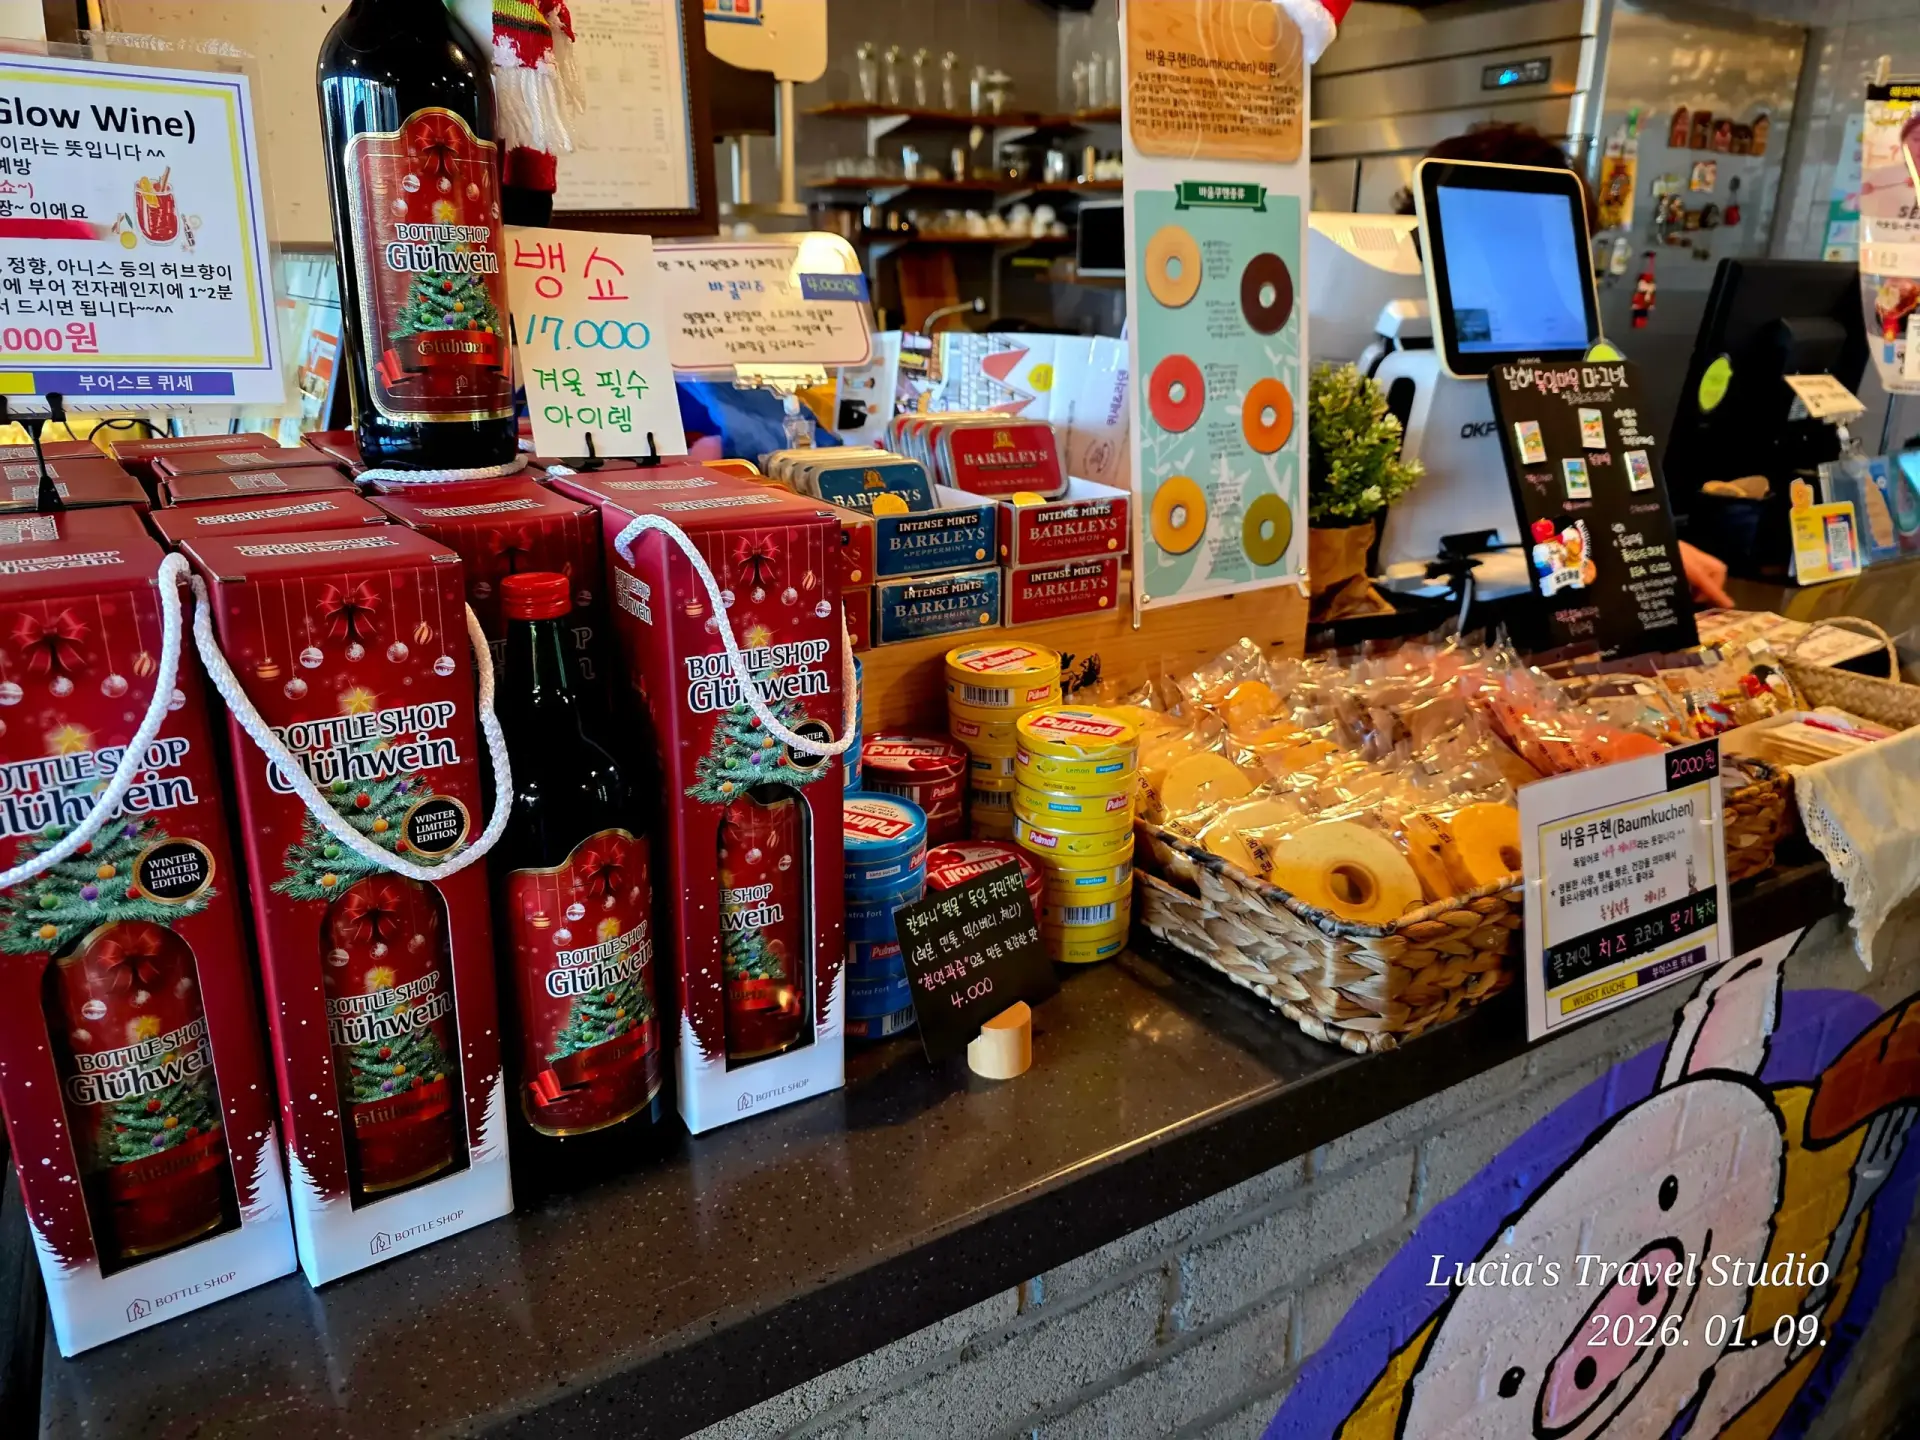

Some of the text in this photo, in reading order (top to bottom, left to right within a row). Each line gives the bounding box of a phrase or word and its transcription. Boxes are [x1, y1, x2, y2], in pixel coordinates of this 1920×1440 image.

[90, 105, 195, 144] Wine)
[65, 140, 141, 161] 뜻입니다
[30, 202, 88, 219] 이에요
[386, 242, 499, 273] Glühwein
[7, 257, 233, 281] 정향, 아니스 등의 허브향이
[0, 278, 233, 301] 에 부어 전자레인지에 1~2분
[17, 299, 74, 317] 드시면
[526, 314, 650, 351] 17.000
[78, 374, 194, 392] 부어스트 퀴세
[532, 368, 650, 400] 겨울 필수
[899, 515, 977, 532] INTENSE MINTS
[1038, 506, 1110, 522] INTENSE MINTS
[890, 527, 985, 550] BARKLEYS
[1029, 518, 1117, 540] BARKLEYS
[1031, 565, 1101, 582] INTENSE MINTS
[904, 581, 981, 599] INTENSE MINTS
[1023, 577, 1108, 599] BARKLEYS
[894, 592, 989, 617] BARKLEYS
[1036, 716, 1118, 736] Pulmoll
[867, 745, 944, 756] Pulmoll
[1671, 750, 1716, 779] 2000원
[415, 808, 456, 825] WINTER
[416, 819, 457, 834] LIMITED
[1560, 799, 1694, 850] 바움쿠헨(Baumkuchen)
[416, 828, 458, 844] EDITION
[1030, 833, 1056, 847] Pulmoll
[148, 852, 198, 870] WINTER
[150, 862, 199, 880] LIMITED
[152, 872, 201, 890] EDITION
[968, 887, 988, 908] 독일
[867, 910, 882, 918] Fort
[950, 977, 993, 1008] 4.000
[1573, 989, 1599, 1007] WURST
[756, 1078, 810, 1103] BOTTLE SHOP
[394, 1209, 464, 1243] BOTTLE SHOP
[154, 1271, 237, 1308] BOTTLE SHOP
